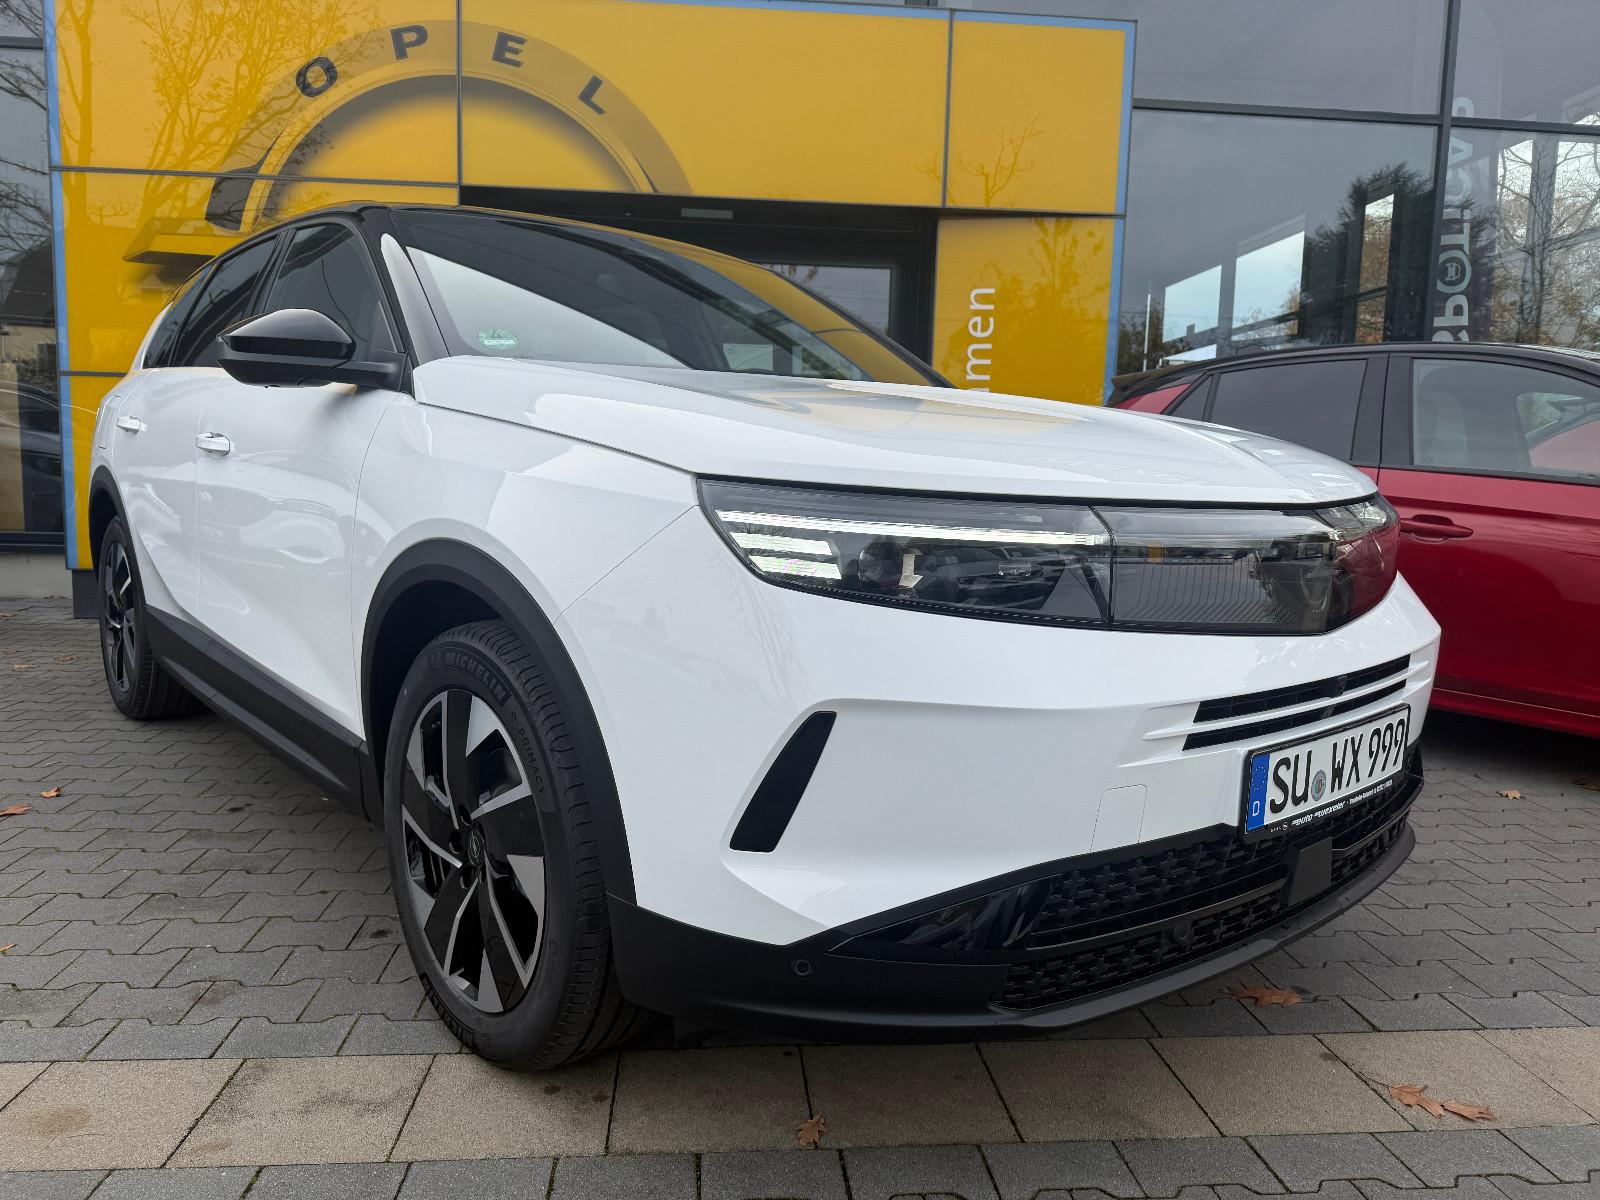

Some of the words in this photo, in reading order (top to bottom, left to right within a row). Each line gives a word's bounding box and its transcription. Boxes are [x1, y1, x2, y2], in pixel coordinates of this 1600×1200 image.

[295, 24, 607, 115] OPEL
[966, 288, 995, 392] men
[444, 651, 509, 701] MICHELIN
[1252, 801, 1260, 816] D
[1270, 750, 1312, 814] SU
[1330, 733, 1363, 793] WX
[1368, 718, 1405, 777] 999
